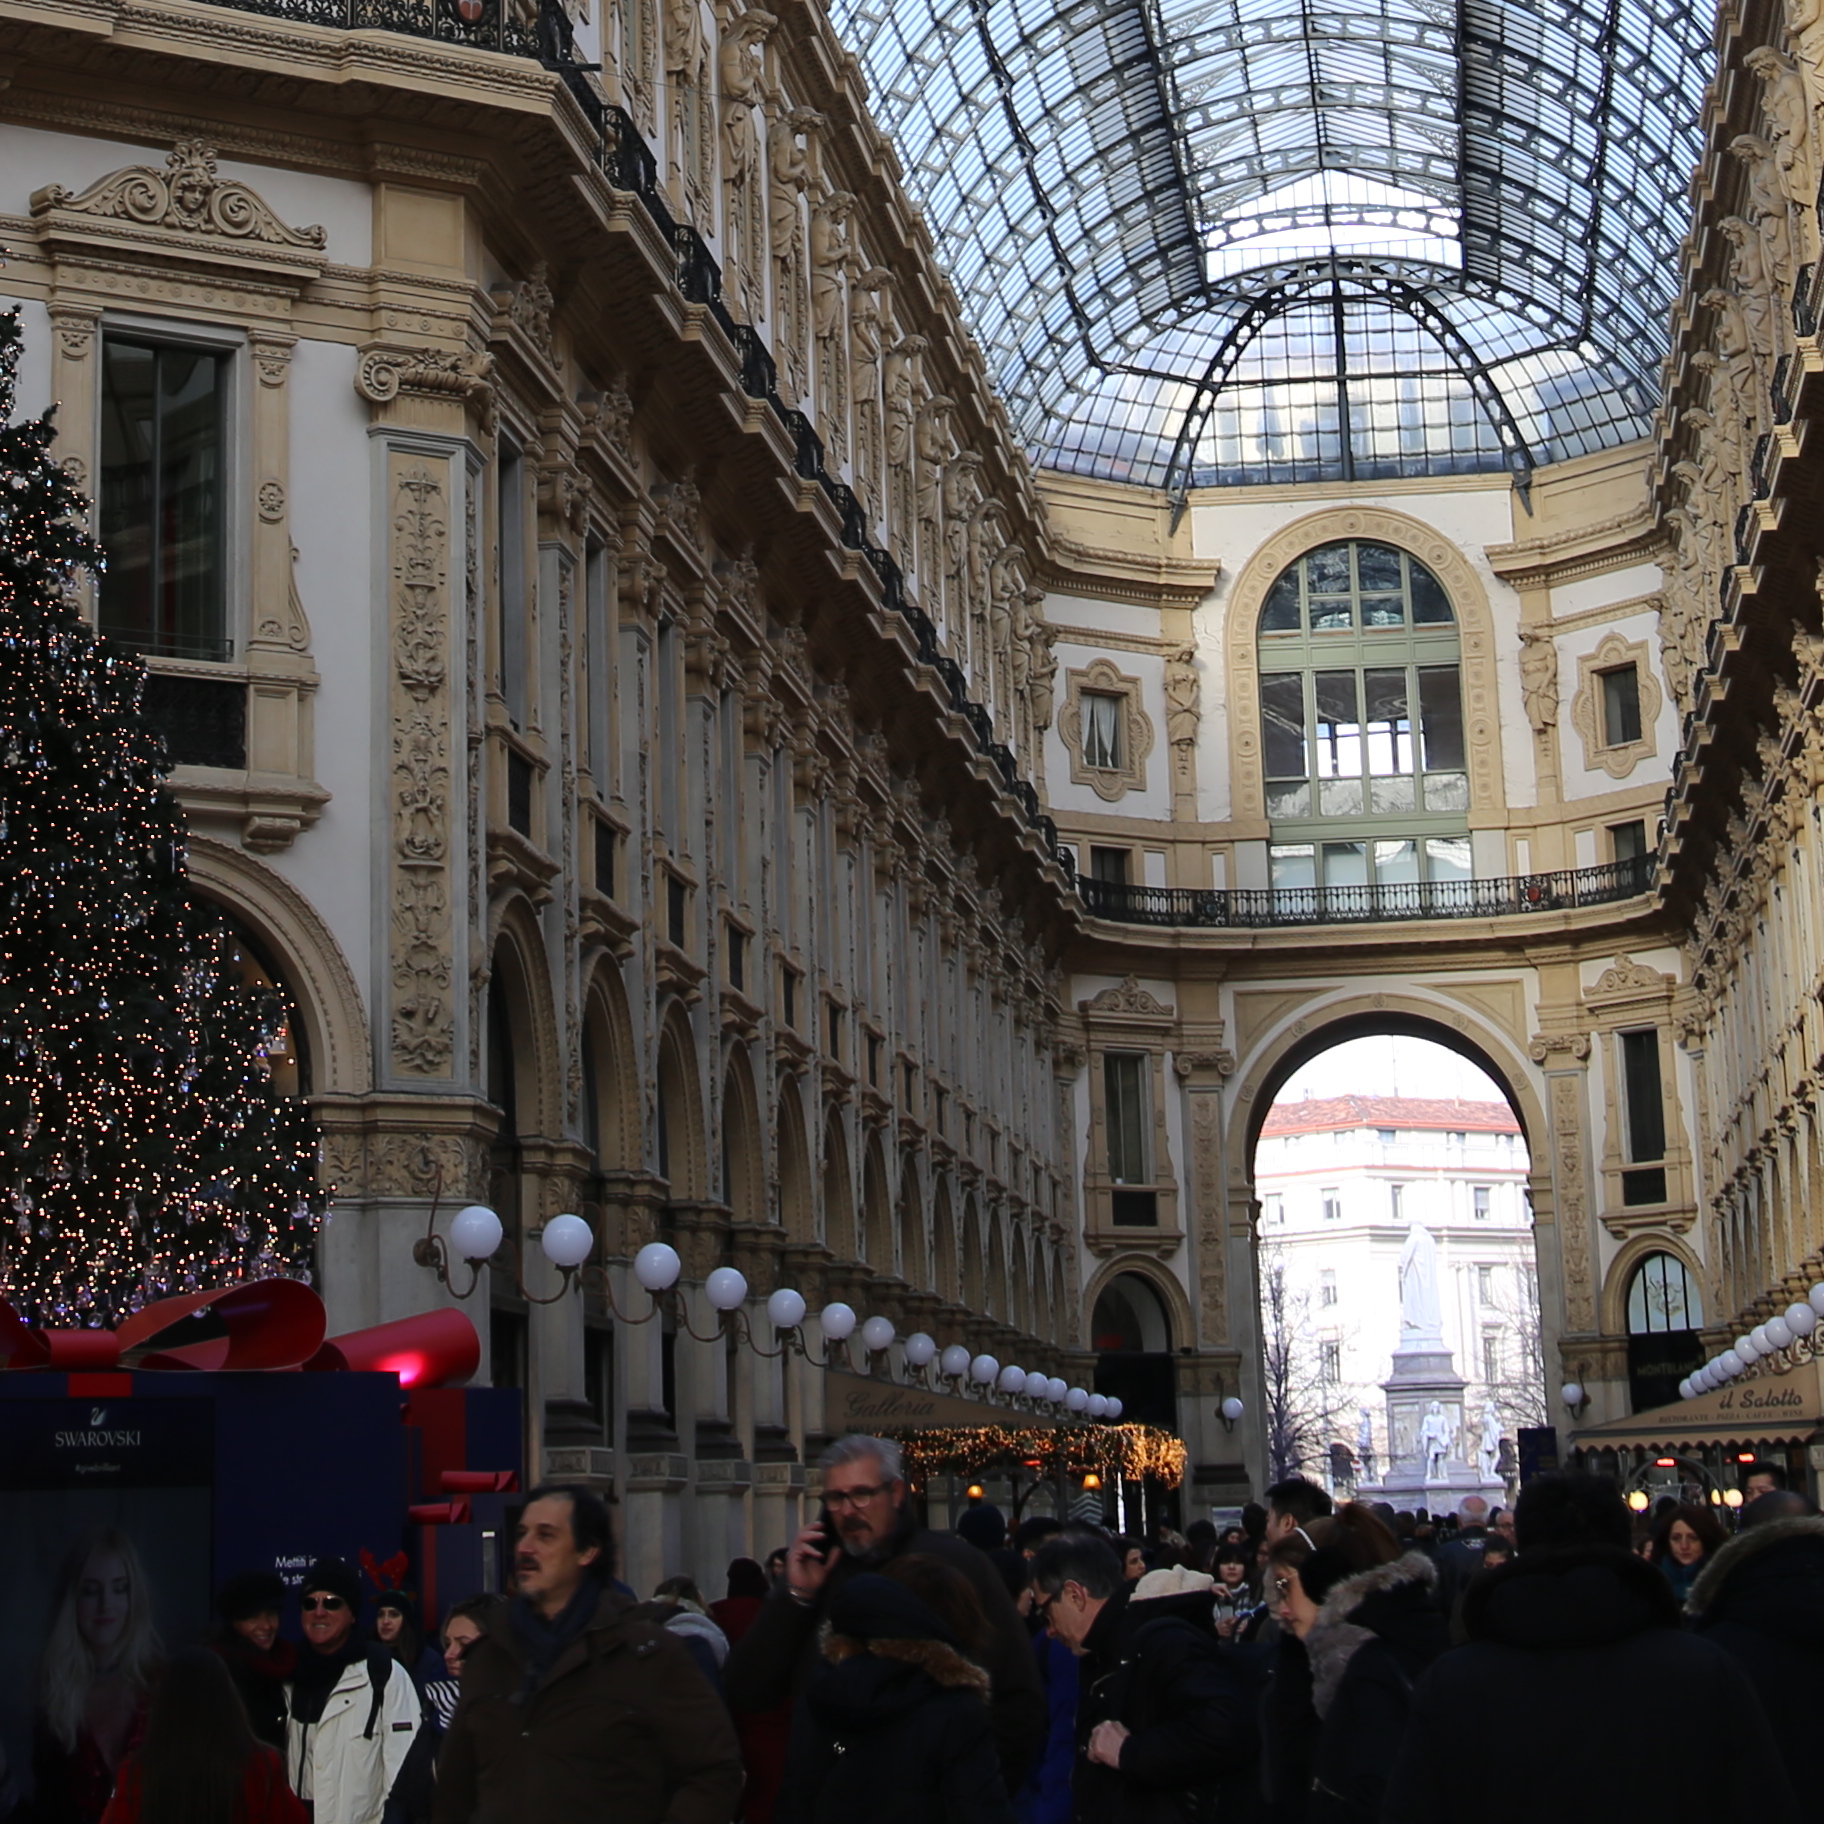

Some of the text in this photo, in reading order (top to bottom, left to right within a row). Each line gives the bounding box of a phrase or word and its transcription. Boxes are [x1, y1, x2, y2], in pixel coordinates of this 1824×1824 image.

[843, 1390, 936, 1419] Galleria
[1719, 1387, 1804, 1409] il Salotto
[1716, 1412, 1741, 1422] PIZZA
[54, 1429, 141, 1448] SWAROVSKI
